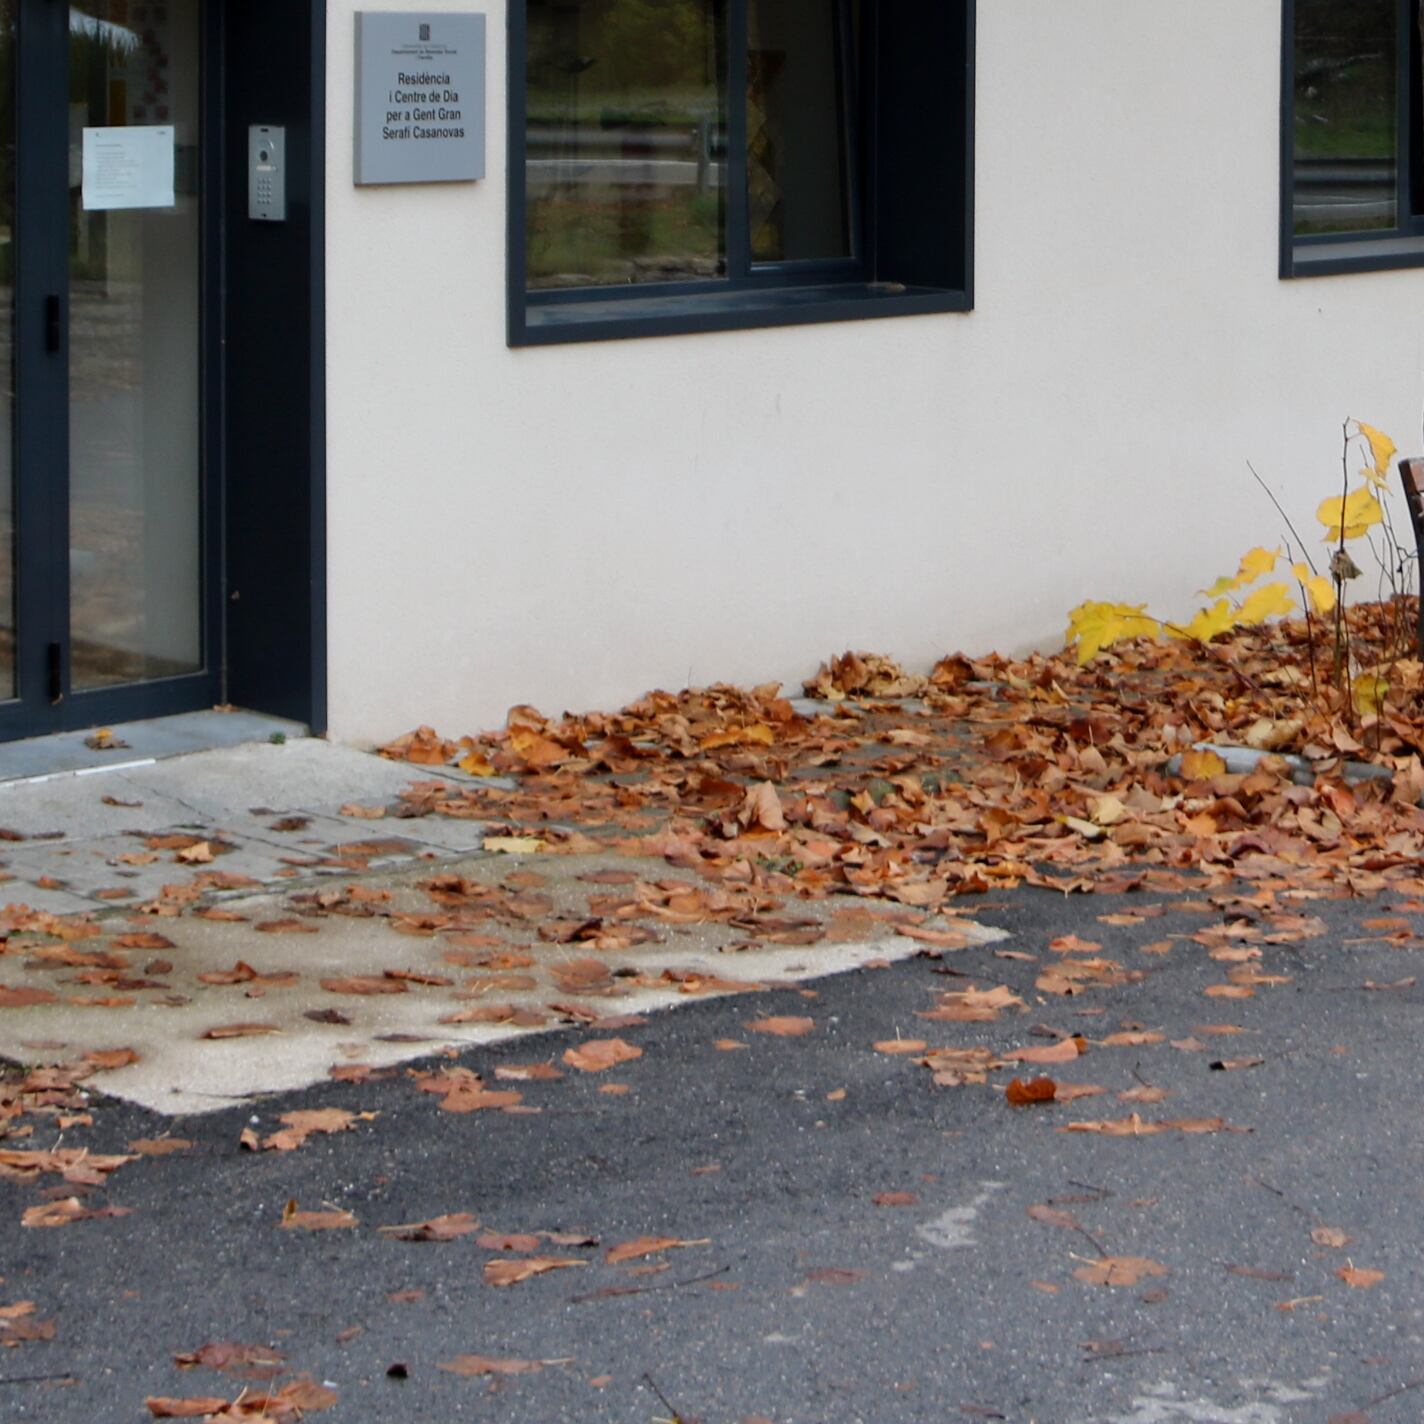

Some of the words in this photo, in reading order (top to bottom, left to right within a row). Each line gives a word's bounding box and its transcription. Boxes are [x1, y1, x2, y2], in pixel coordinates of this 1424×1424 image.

[398, 72, 450, 85] Residència
[395, 90, 426, 103] Centre
[429, 90, 441, 103] de
[443, 90, 458, 103] Dia
[386, 110, 402, 124] per
[404, 111, 410, 121] a
[413, 108, 436, 121] Gent
[438, 107, 461, 120] Gran
[413, 126, 465, 139] Casanovas
